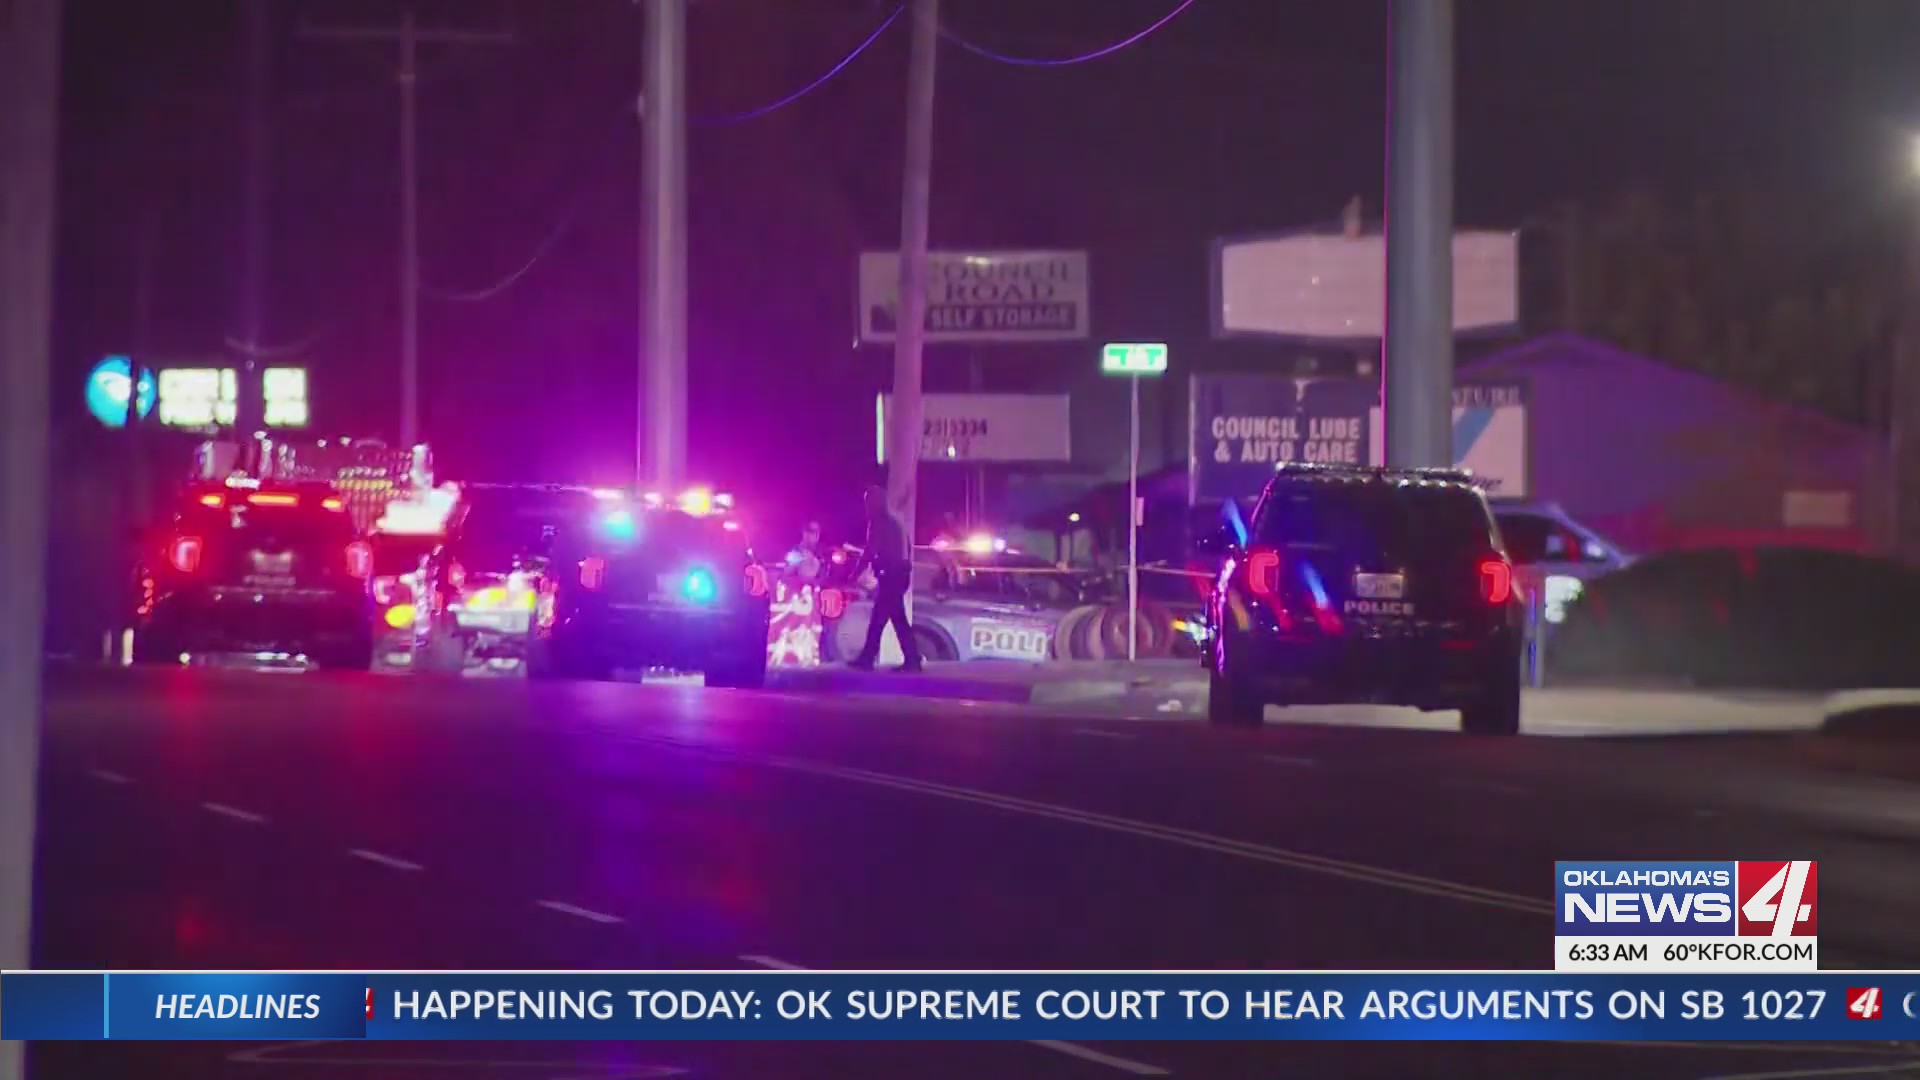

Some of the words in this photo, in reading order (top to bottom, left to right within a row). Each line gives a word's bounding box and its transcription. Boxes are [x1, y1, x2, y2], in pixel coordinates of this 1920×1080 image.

[945, 283, 1055, 302] ROAD
[932, 308, 975, 328] SELF
[982, 307, 1070, 326] STORAGE
[1211, 416, 1299, 439] COUNCIL
[1309, 418, 1361, 439] LUBE
[1214, 441, 1231, 463] &
[1240, 441, 1295, 462] AUTO
[1303, 441, 1358, 462] CARE
[1343, 600, 1415, 616] POLICE
